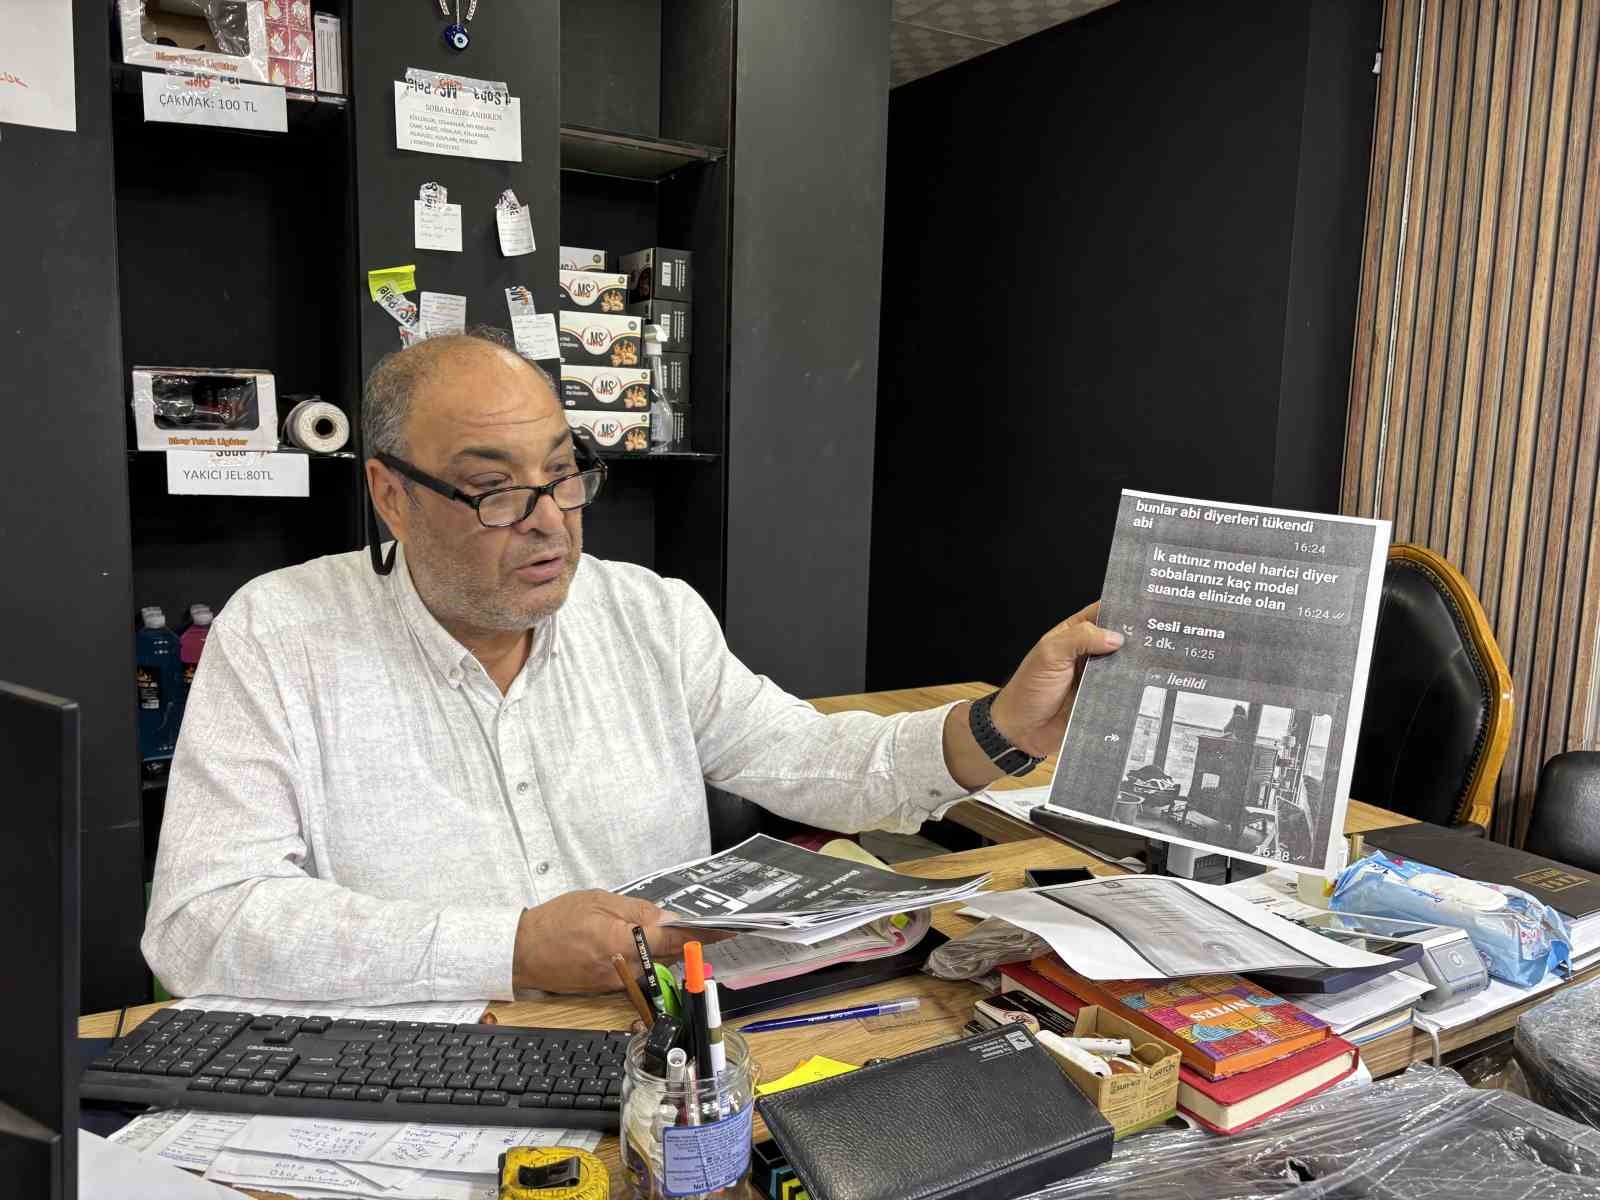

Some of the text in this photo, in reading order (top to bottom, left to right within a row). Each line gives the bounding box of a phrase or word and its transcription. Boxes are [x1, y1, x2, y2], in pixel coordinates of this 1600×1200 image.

[218, 98, 240, 111] 100
[244, 101, 258, 113] TL
[217, 436, 249, 447] Lighter
[183, 469, 222, 480] YAKICI
[1132, 516, 1153, 530] abi
[1135, 500, 1314, 534] bunlar abi diyerleri tükendi
[1294, 542, 1326, 555] 16:24
[1168, 551, 1212, 568] attınız
[1213, 558, 1257, 574] model
[1259, 563, 1299, 579] harici
[1302, 569, 1338, 585] diyer
[1150, 566, 1299, 597] sobalarınız kaç model
[1147, 582, 1286, 611] suanda elinizde olan
[1297, 607, 1330, 620] 16:24
[1147, 617, 1225, 640] Sesli arama
[1144, 635, 1216, 660] 2 dk. 16:25
[1190, 1000, 1250, 1022] NOTES
